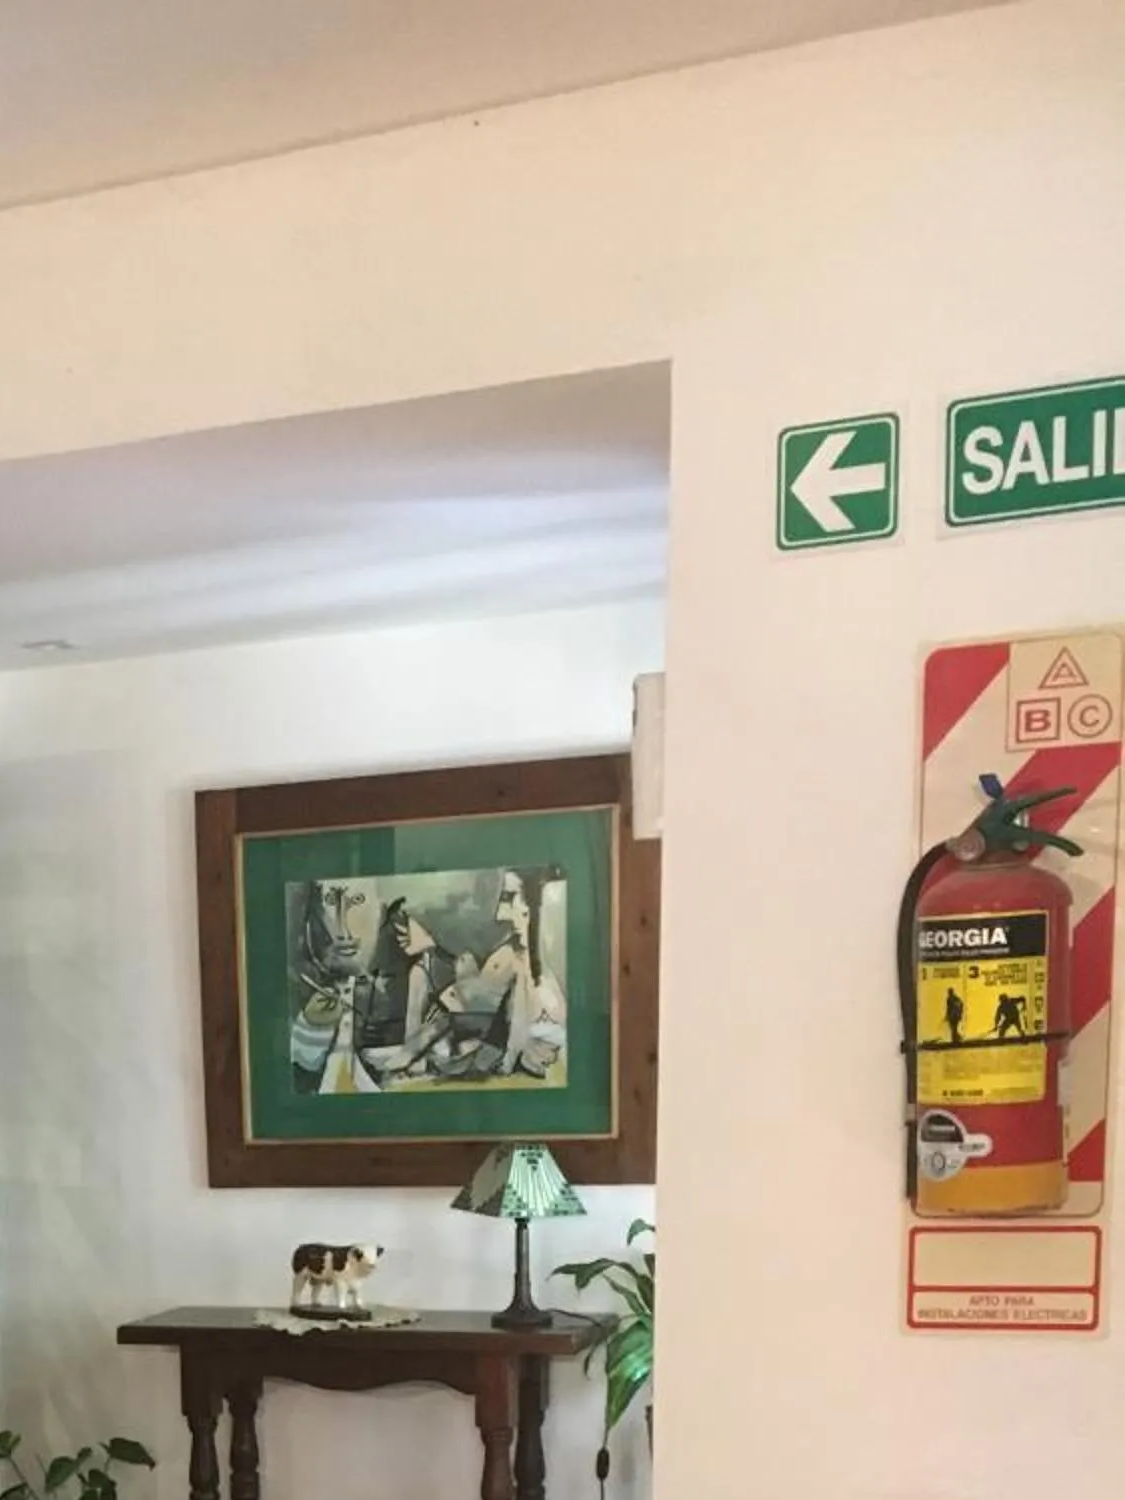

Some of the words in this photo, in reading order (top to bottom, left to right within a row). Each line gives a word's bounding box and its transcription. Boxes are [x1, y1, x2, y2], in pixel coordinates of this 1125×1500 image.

[961, 407, 1125, 494] SALI
[1024, 709, 1051, 733] B
[968, 965, 980, 979] 3
